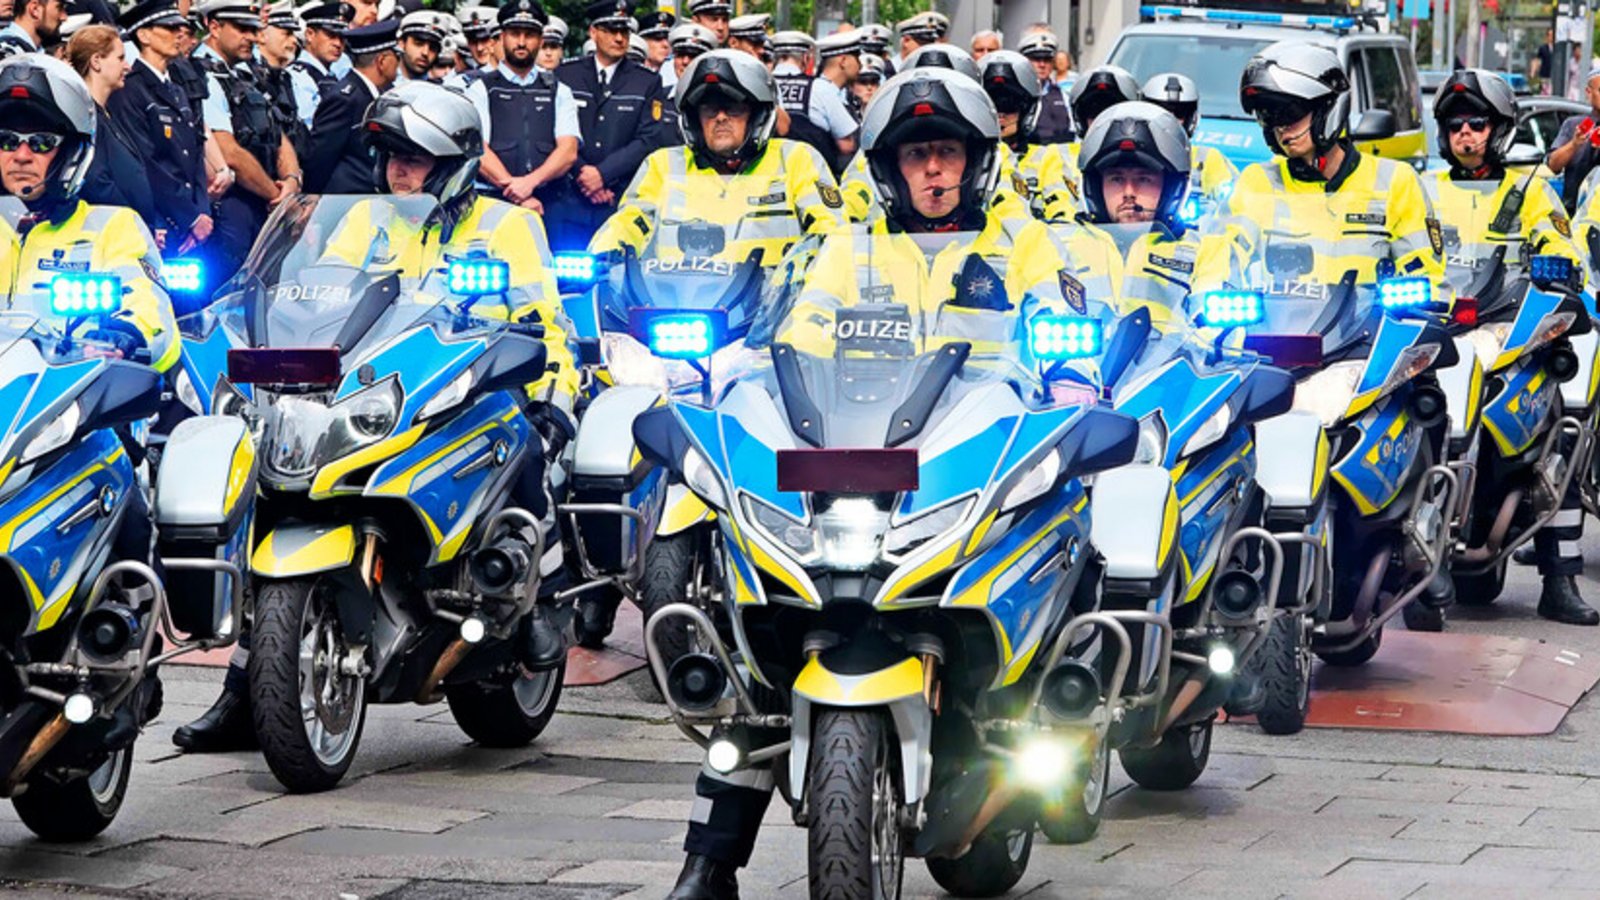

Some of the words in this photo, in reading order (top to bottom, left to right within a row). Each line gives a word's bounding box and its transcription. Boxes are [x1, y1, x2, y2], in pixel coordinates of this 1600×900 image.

[781, 85, 805, 101] ZEI
[1195, 131, 1253, 148] IZEI
[645, 255, 734, 276] POLIZEI
[1447, 253, 1477, 268] ZEI
[274, 284, 351, 304] POLIZEI
[1251, 279, 1328, 300] OLIZEI
